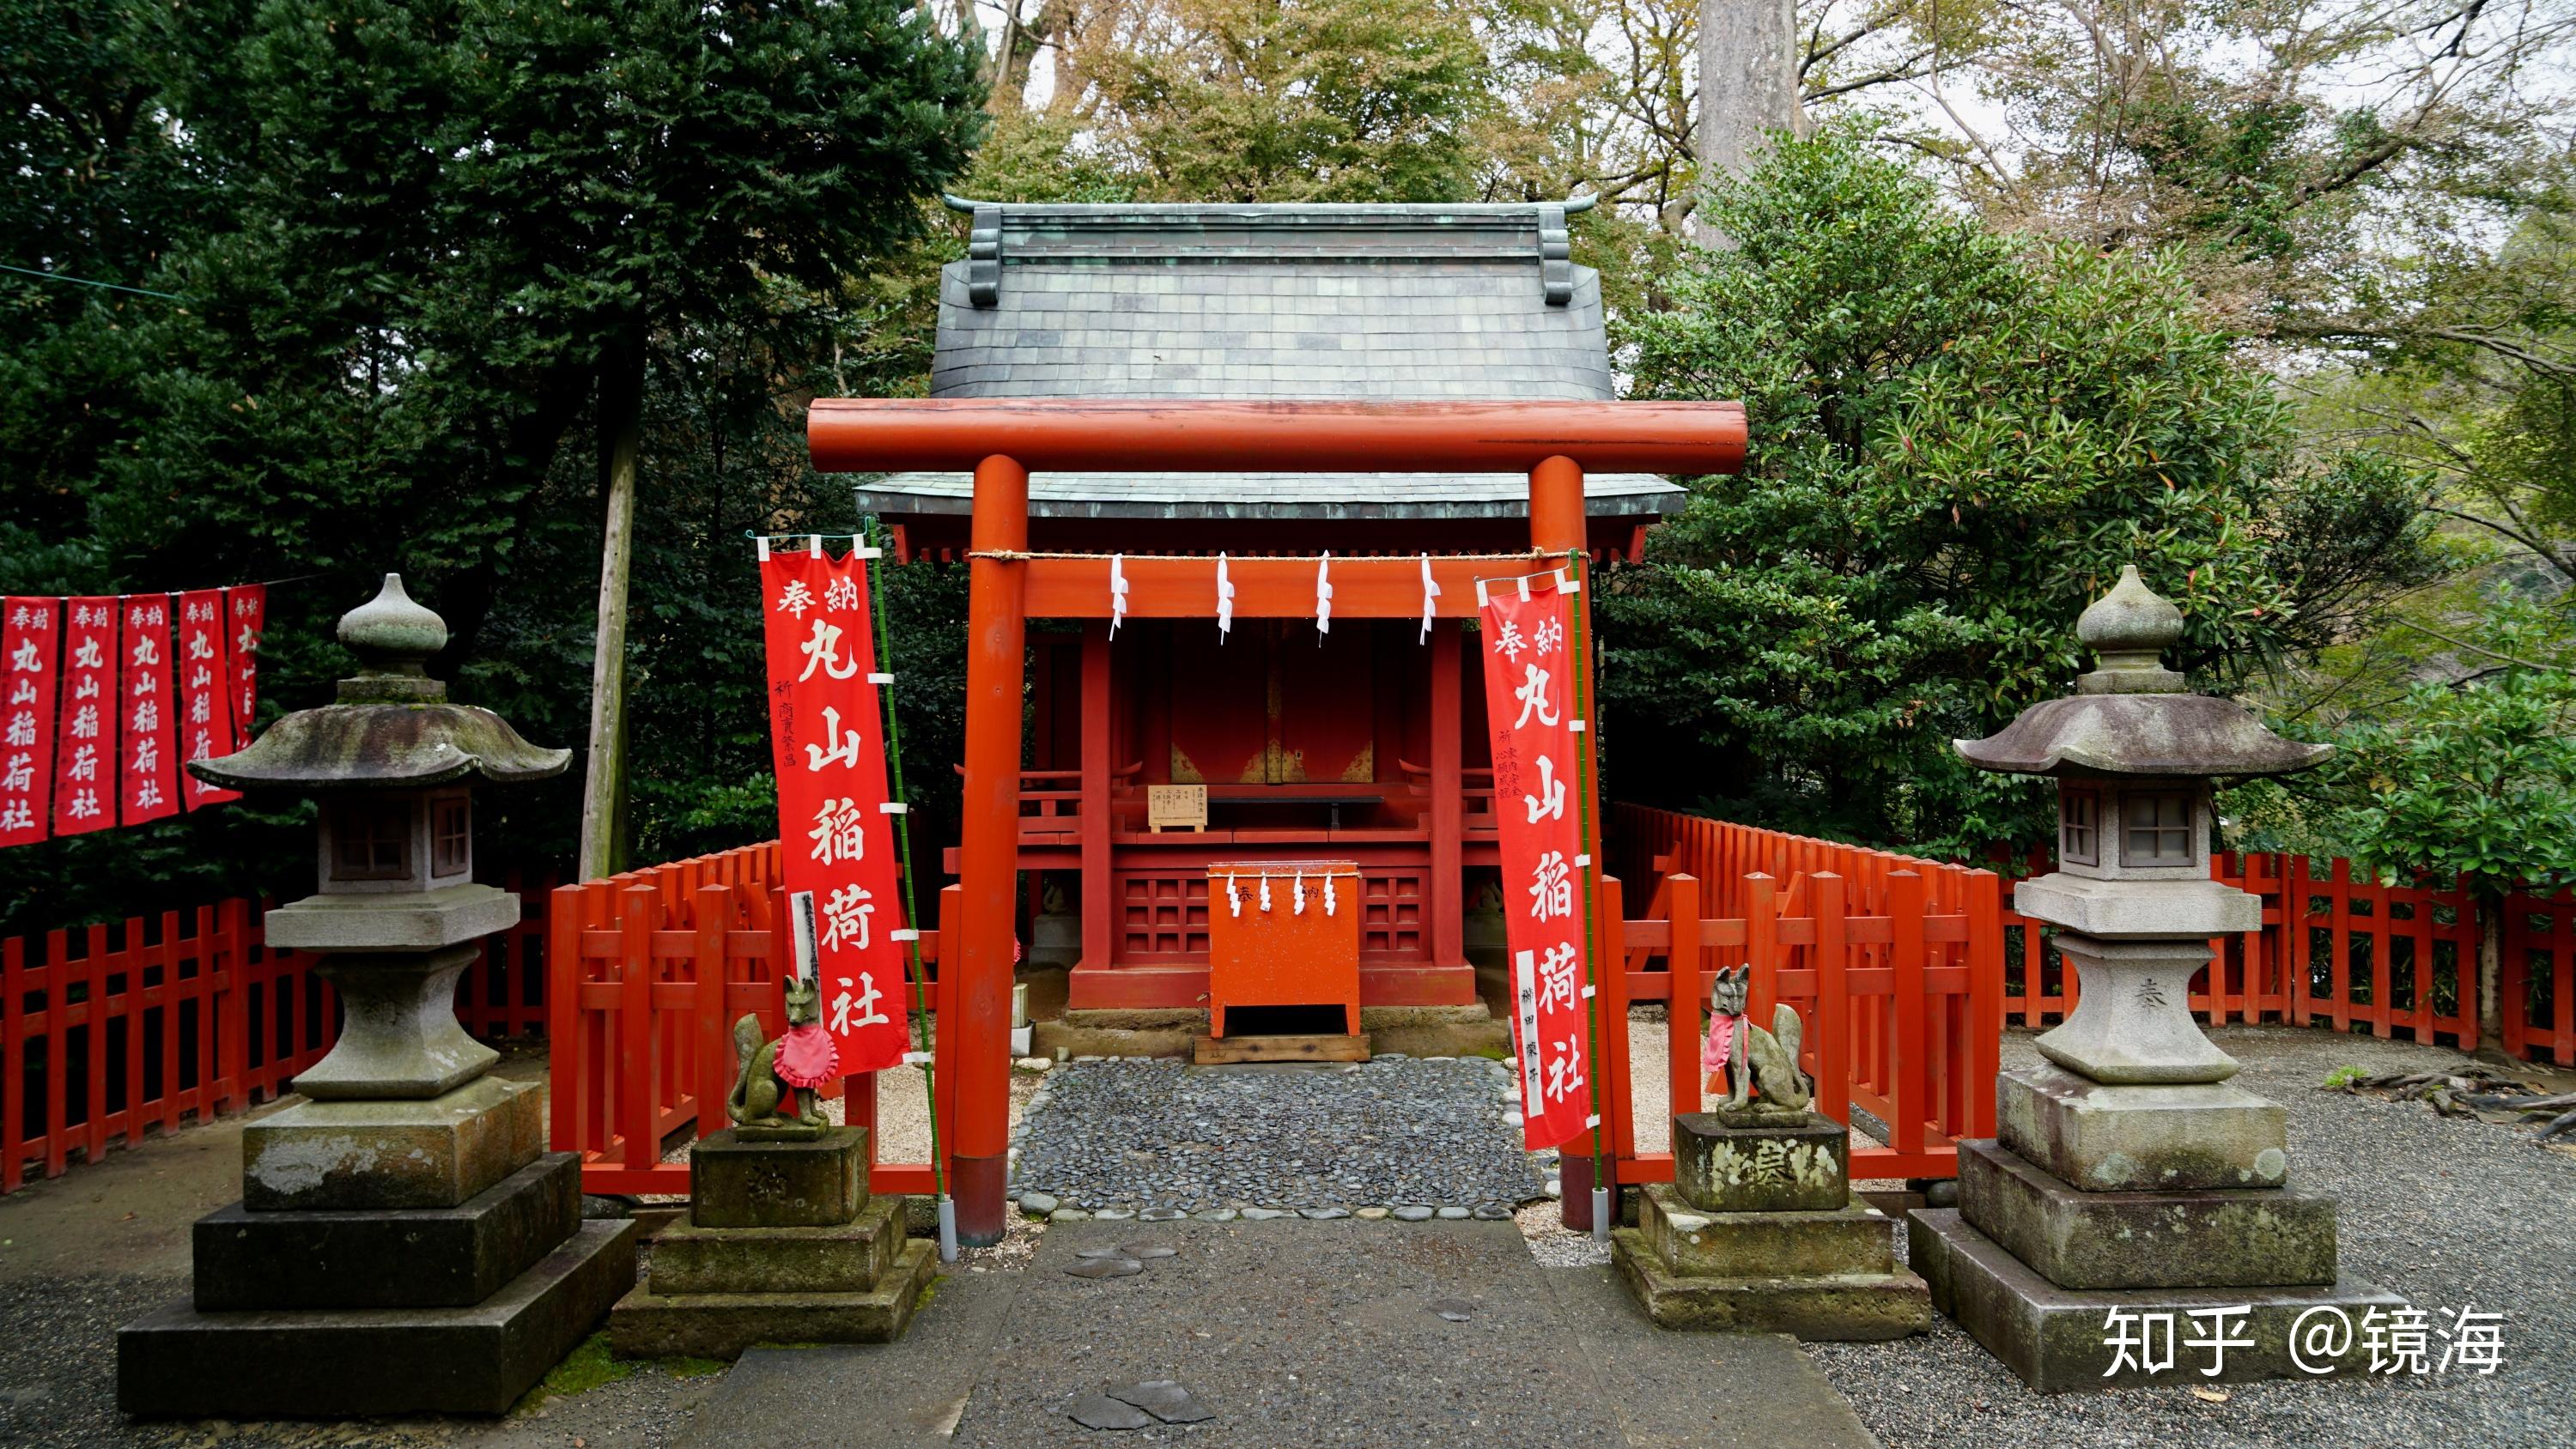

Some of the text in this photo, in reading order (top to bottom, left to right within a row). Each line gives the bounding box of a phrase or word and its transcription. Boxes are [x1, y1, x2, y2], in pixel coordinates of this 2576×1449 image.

[10, 605, 49, 630] 奉納
[74, 604, 107, 629] 奉納
[131, 605, 164, 628] 奉納
[186, 602, 214, 624] 奉納
[776, 576, 859, 620] 奉納
[1495, 615, 1563, 664] 奉納
[0, 637, 42, 832] 丸山稲荷社
[69, 635, 104, 819] 丸山稲荷社
[132, 634, 164, 809] 丸山稲荷社
[799, 619, 890, 1036] 丸山稲荷社
[1515, 663, 1583, 1103] 丸山稲荷社
